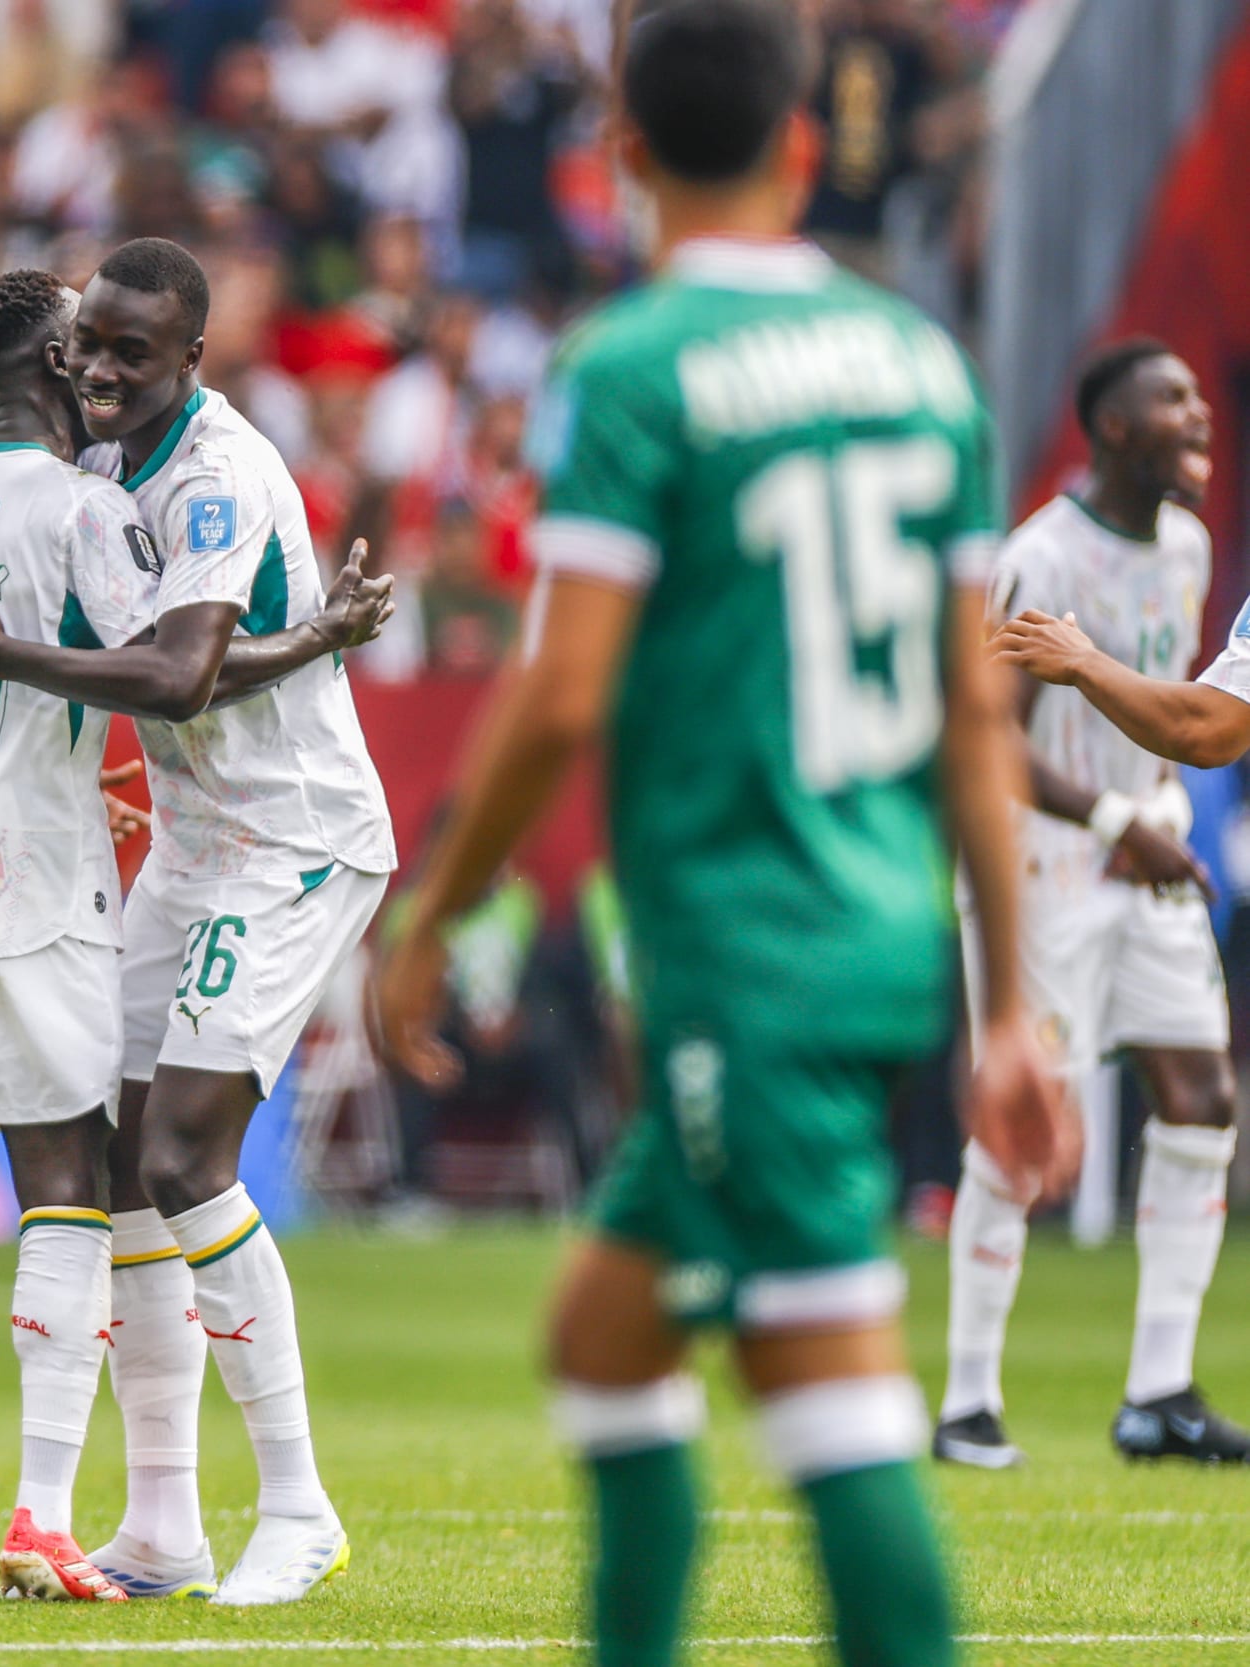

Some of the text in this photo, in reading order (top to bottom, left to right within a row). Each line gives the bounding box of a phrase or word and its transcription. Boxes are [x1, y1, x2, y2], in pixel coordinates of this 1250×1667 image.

[200, 529, 224, 540] PEACE
[735, 435, 958, 792] 15
[175, 913, 247, 998] 26
[11, 1314, 51, 1338] EGAL
